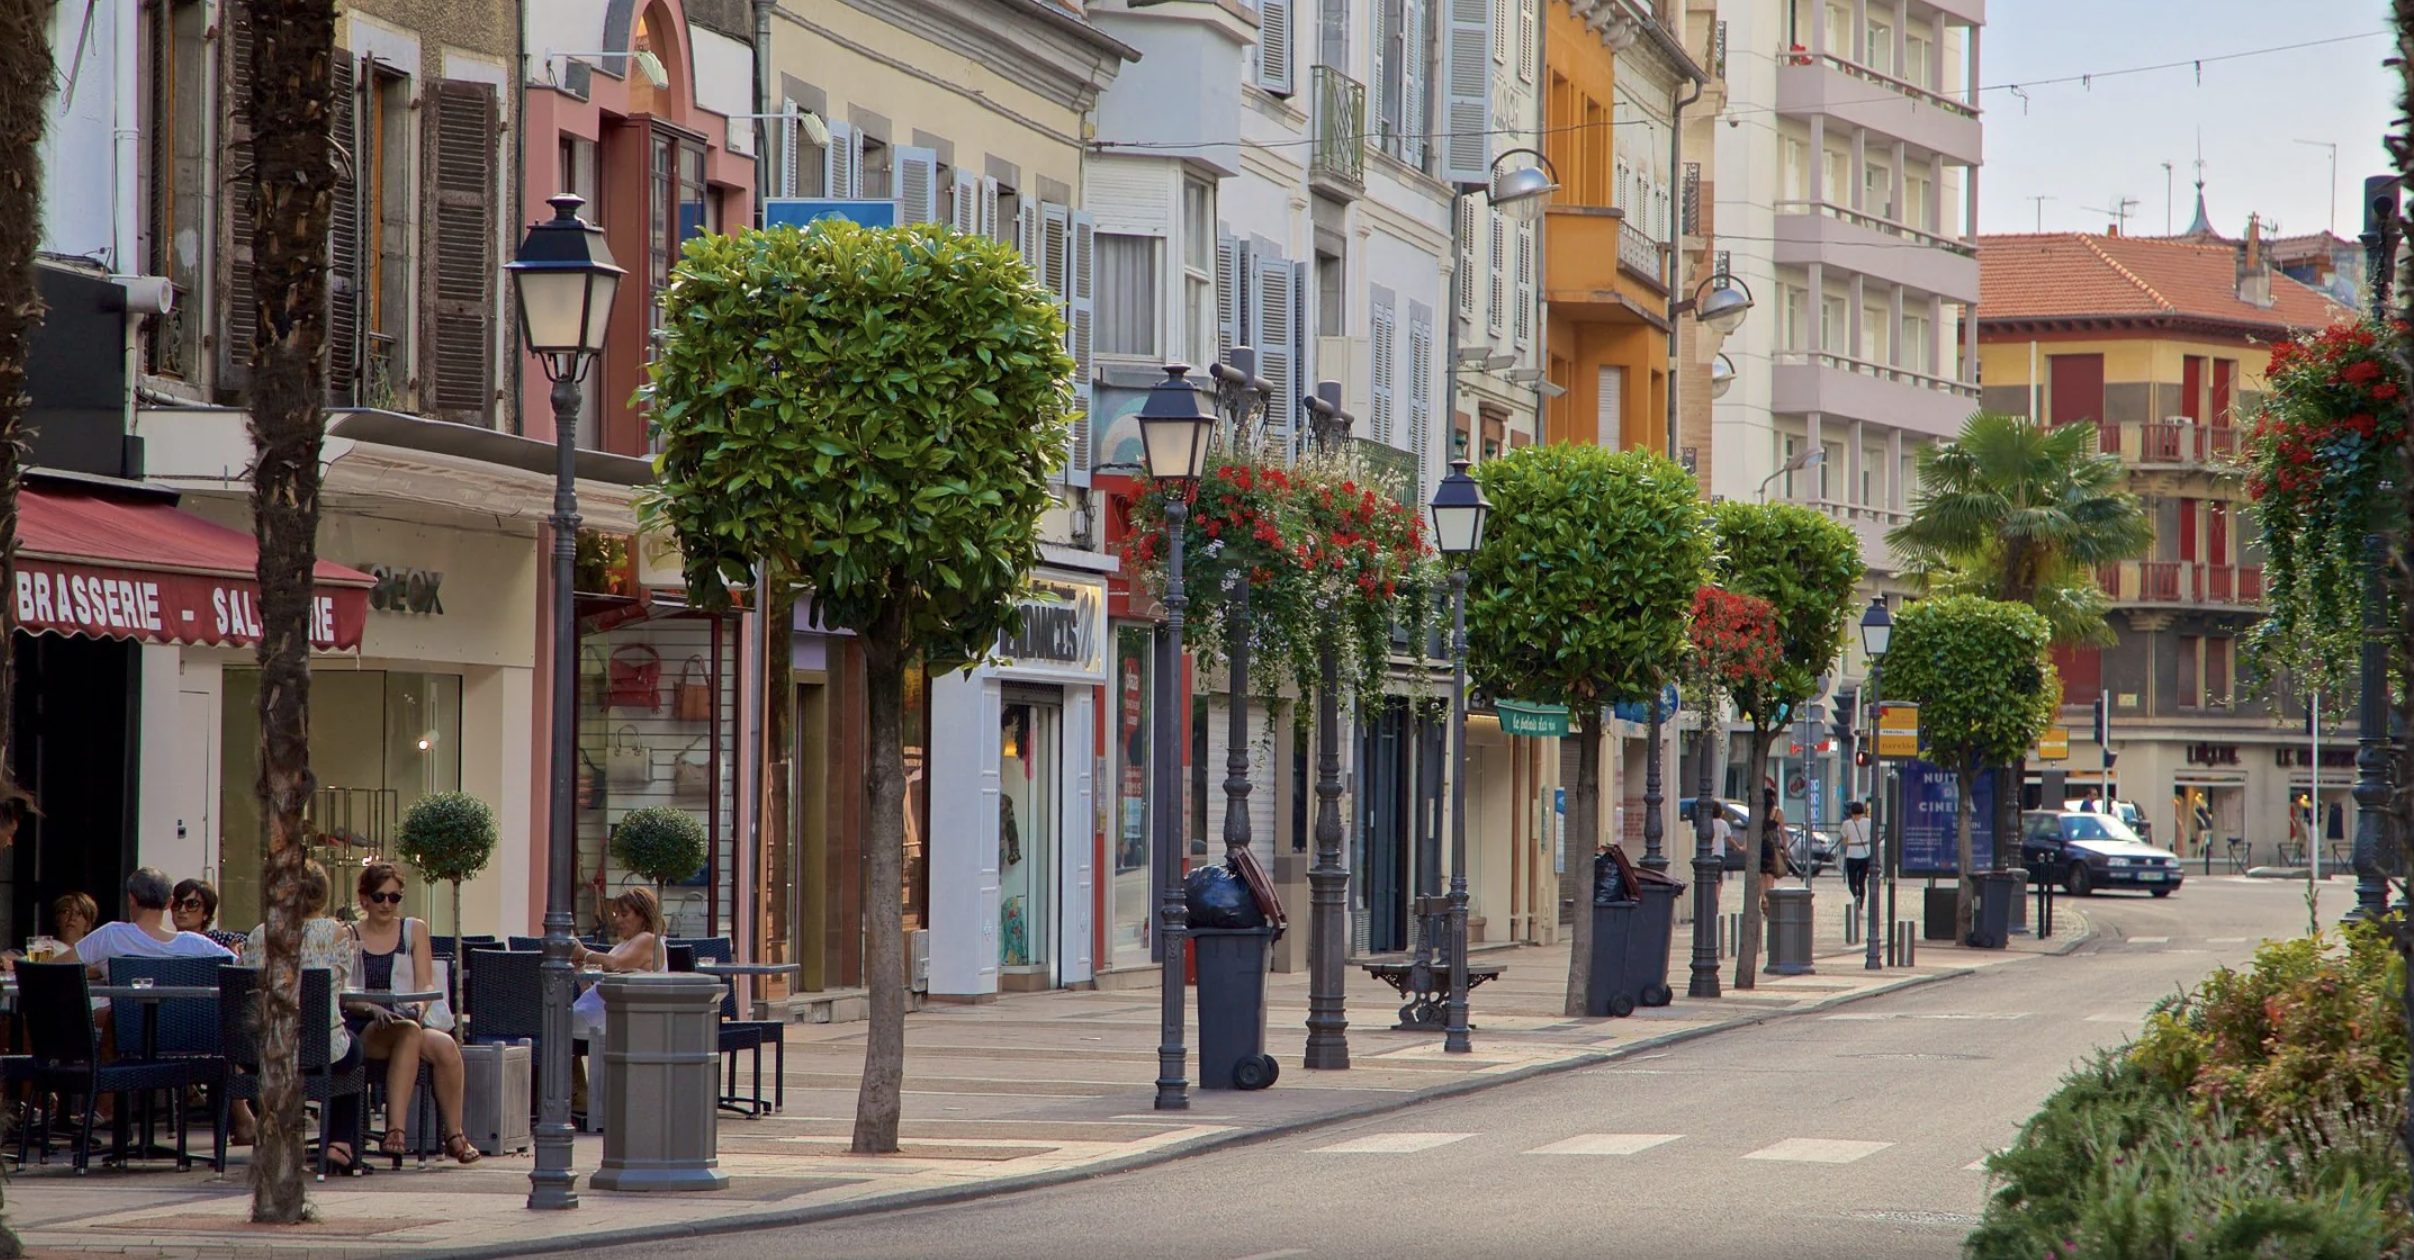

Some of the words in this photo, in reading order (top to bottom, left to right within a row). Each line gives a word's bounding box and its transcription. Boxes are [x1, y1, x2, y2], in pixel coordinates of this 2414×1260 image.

[15, 571, 162, 631] BRASSERIE
[213, 587, 335, 642] SALIE
[369, 562, 444, 615] GEOX
[1923, 772, 1958, 784] NUIT
